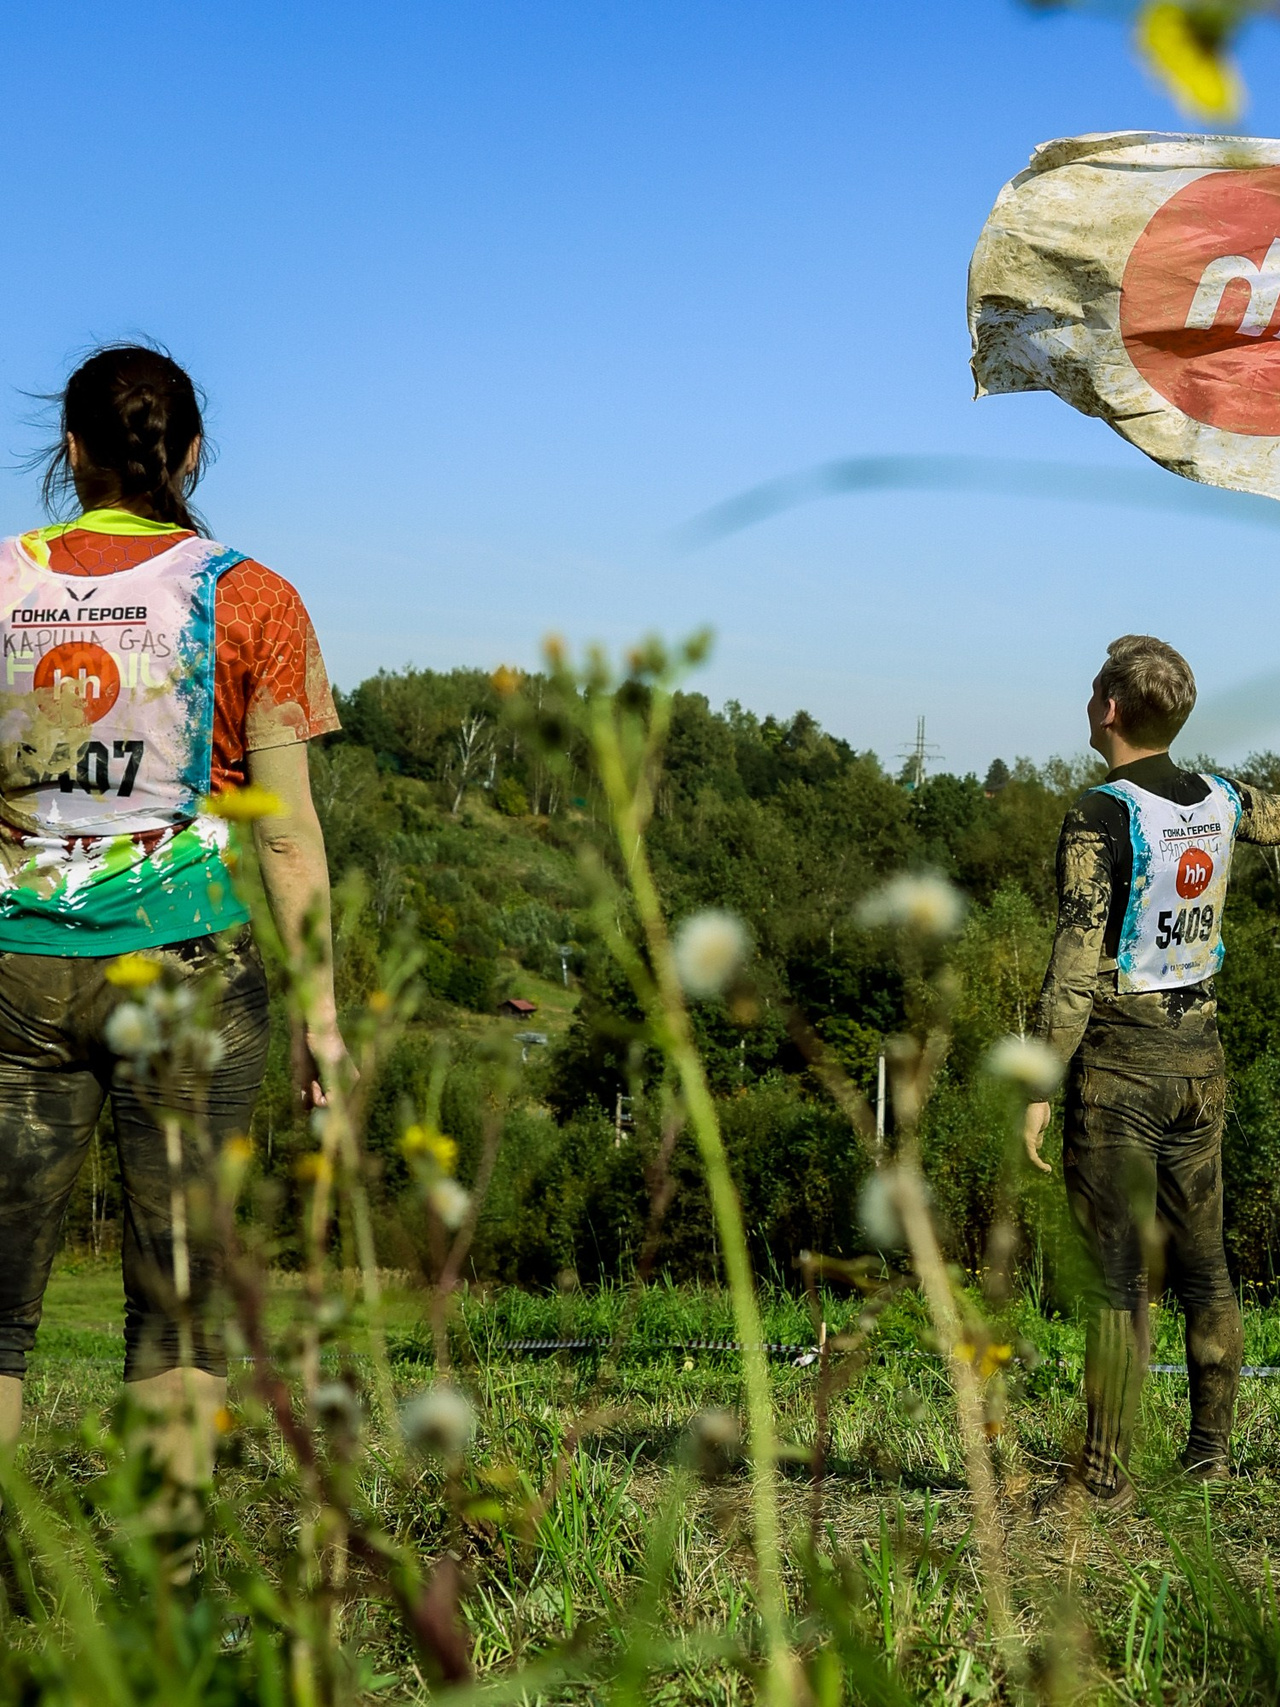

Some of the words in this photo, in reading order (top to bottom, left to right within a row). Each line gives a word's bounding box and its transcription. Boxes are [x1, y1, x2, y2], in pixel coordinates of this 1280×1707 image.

[12, 608, 71, 623] ГОНКА
[77, 606, 148, 622] ГЕРОЕВ
[1162, 828, 1186, 838] ГОНКА
[1186, 822, 1221, 836] ГЕРОЕВ
[1183, 863, 1207, 885] hh
[1155, 904, 1214, 950] 5409
